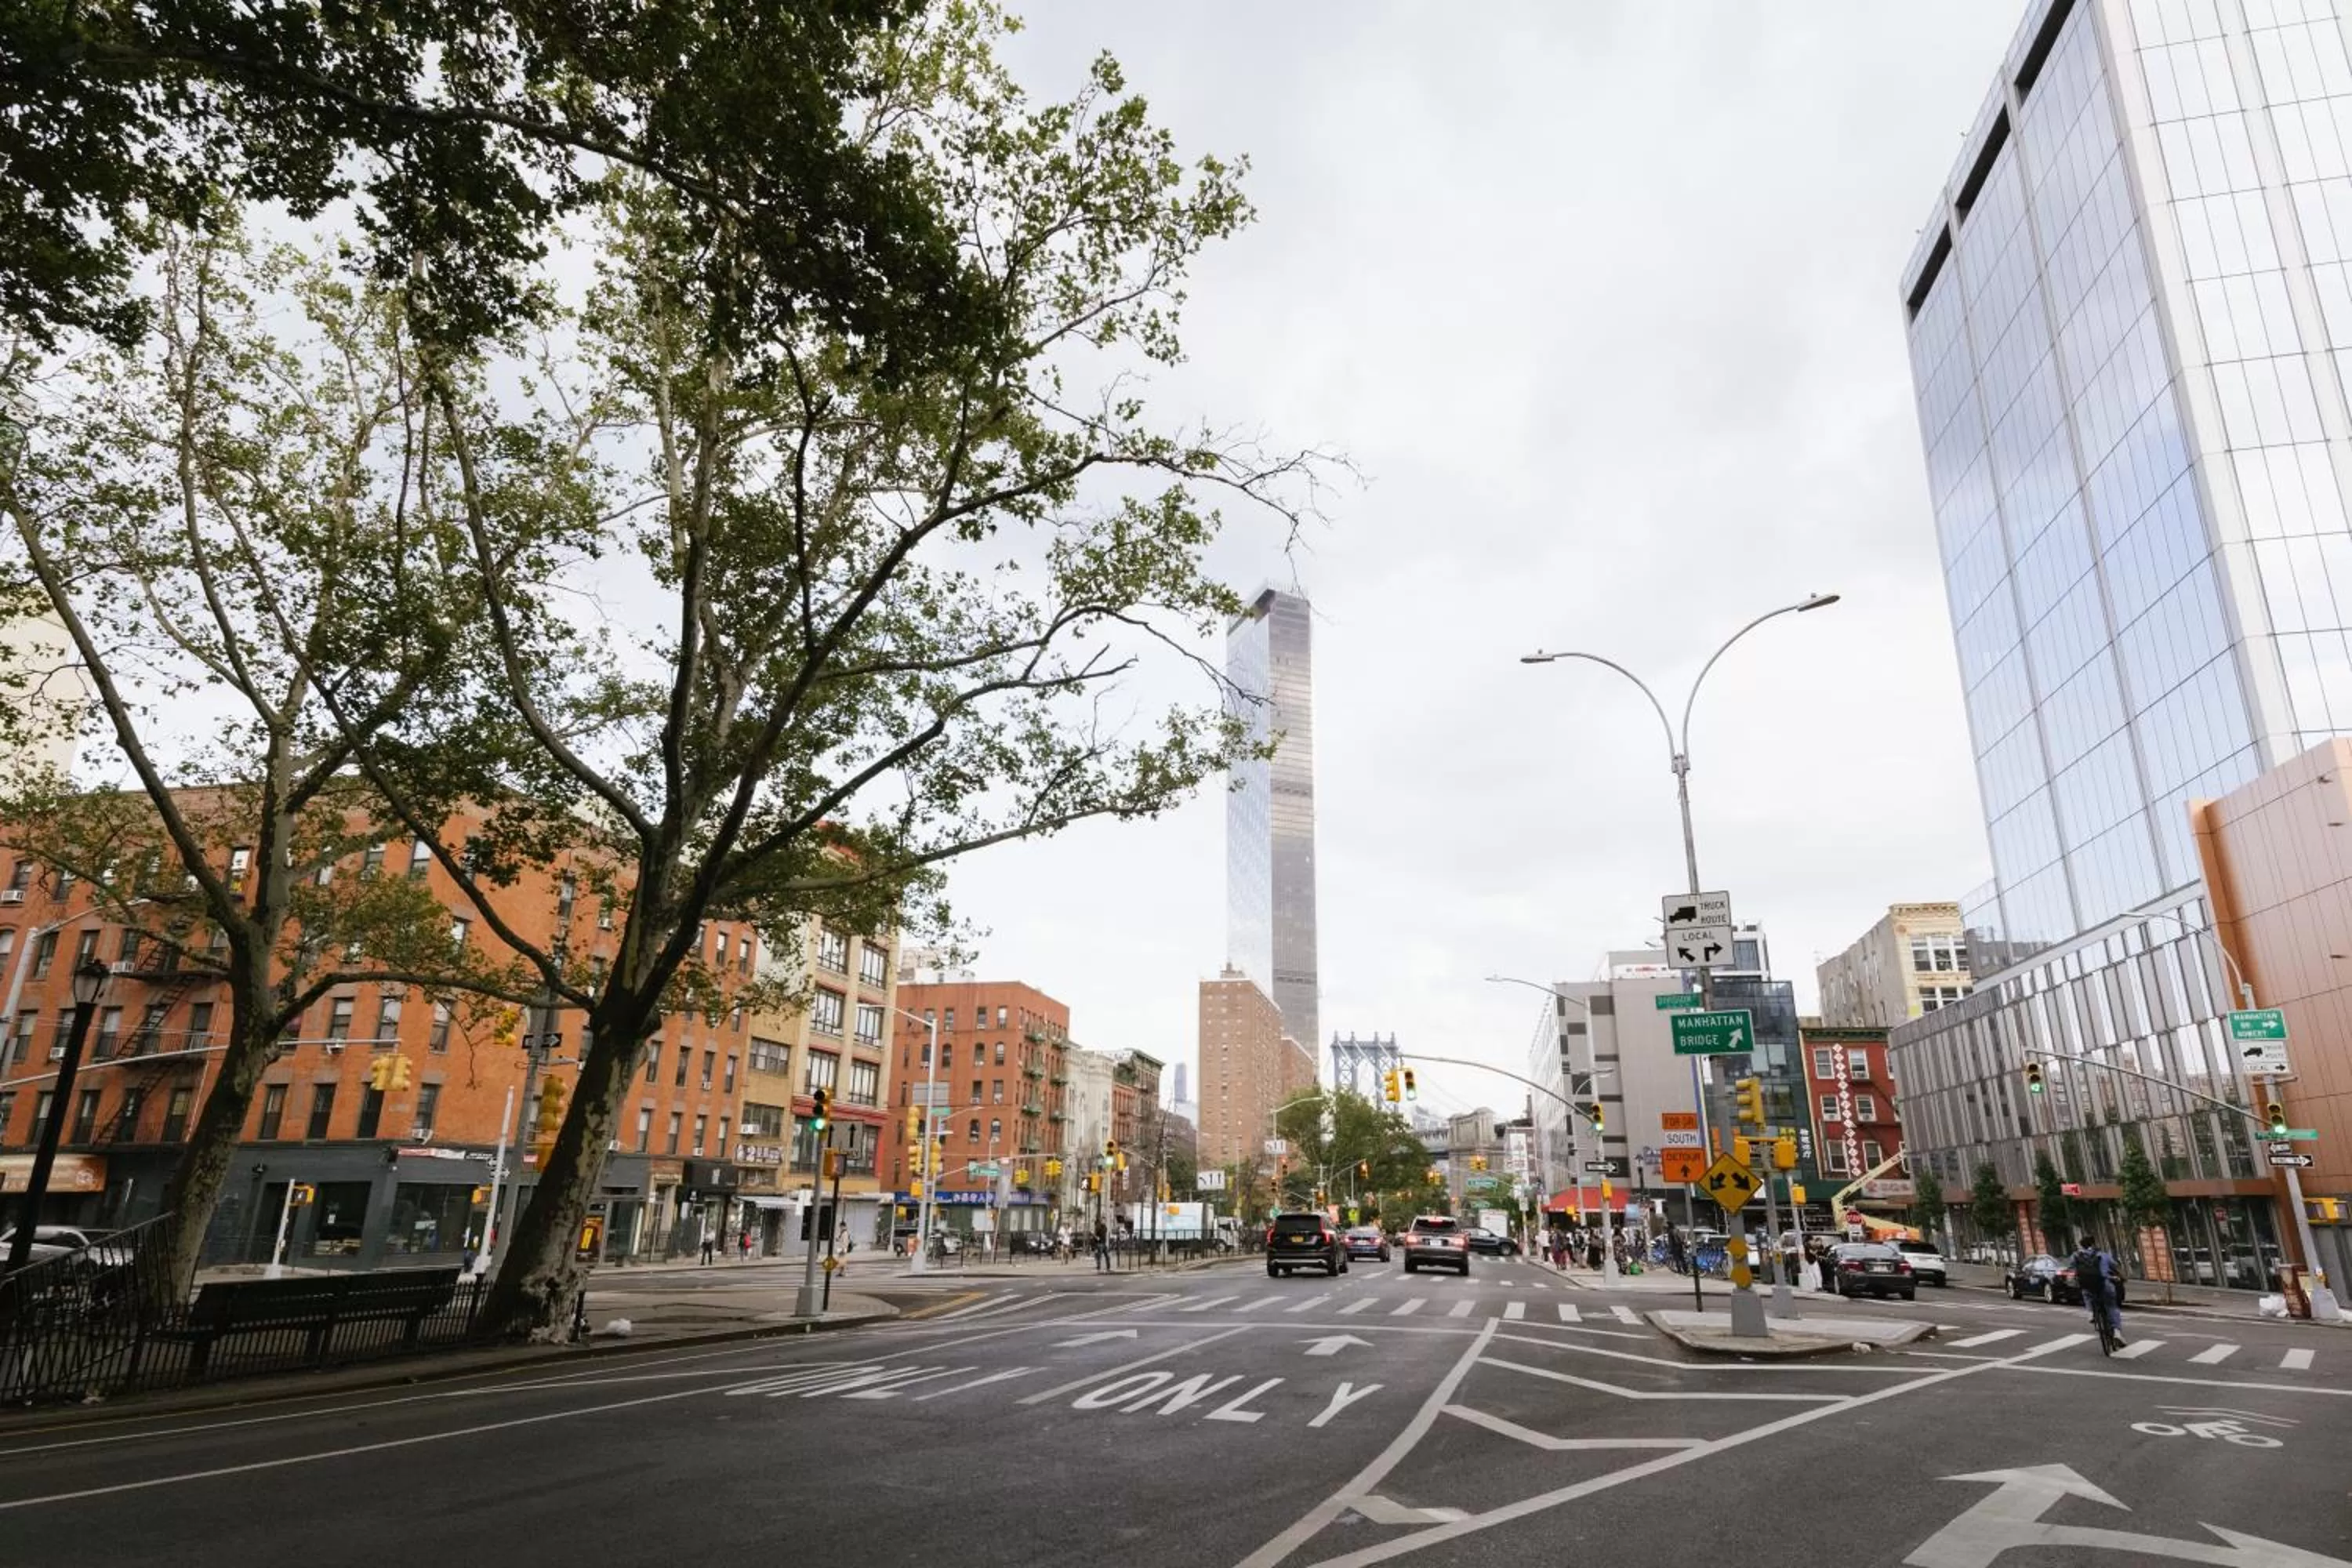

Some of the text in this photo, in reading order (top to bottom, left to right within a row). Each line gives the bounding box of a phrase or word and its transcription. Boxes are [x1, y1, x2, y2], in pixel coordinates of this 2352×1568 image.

[1700, 901, 1726, 910] TRUCK
[1700, 914, 1726, 924] ROUTE
[1682, 931, 1715, 941] LOCAL
[1678, 1015, 1744, 1029] MANHATTAN
[1680, 1035, 1720, 1047] BRIDGE
[1667, 1134, 1697, 1143] SOUTH
[1072, 1371, 1386, 1427] ONLY
